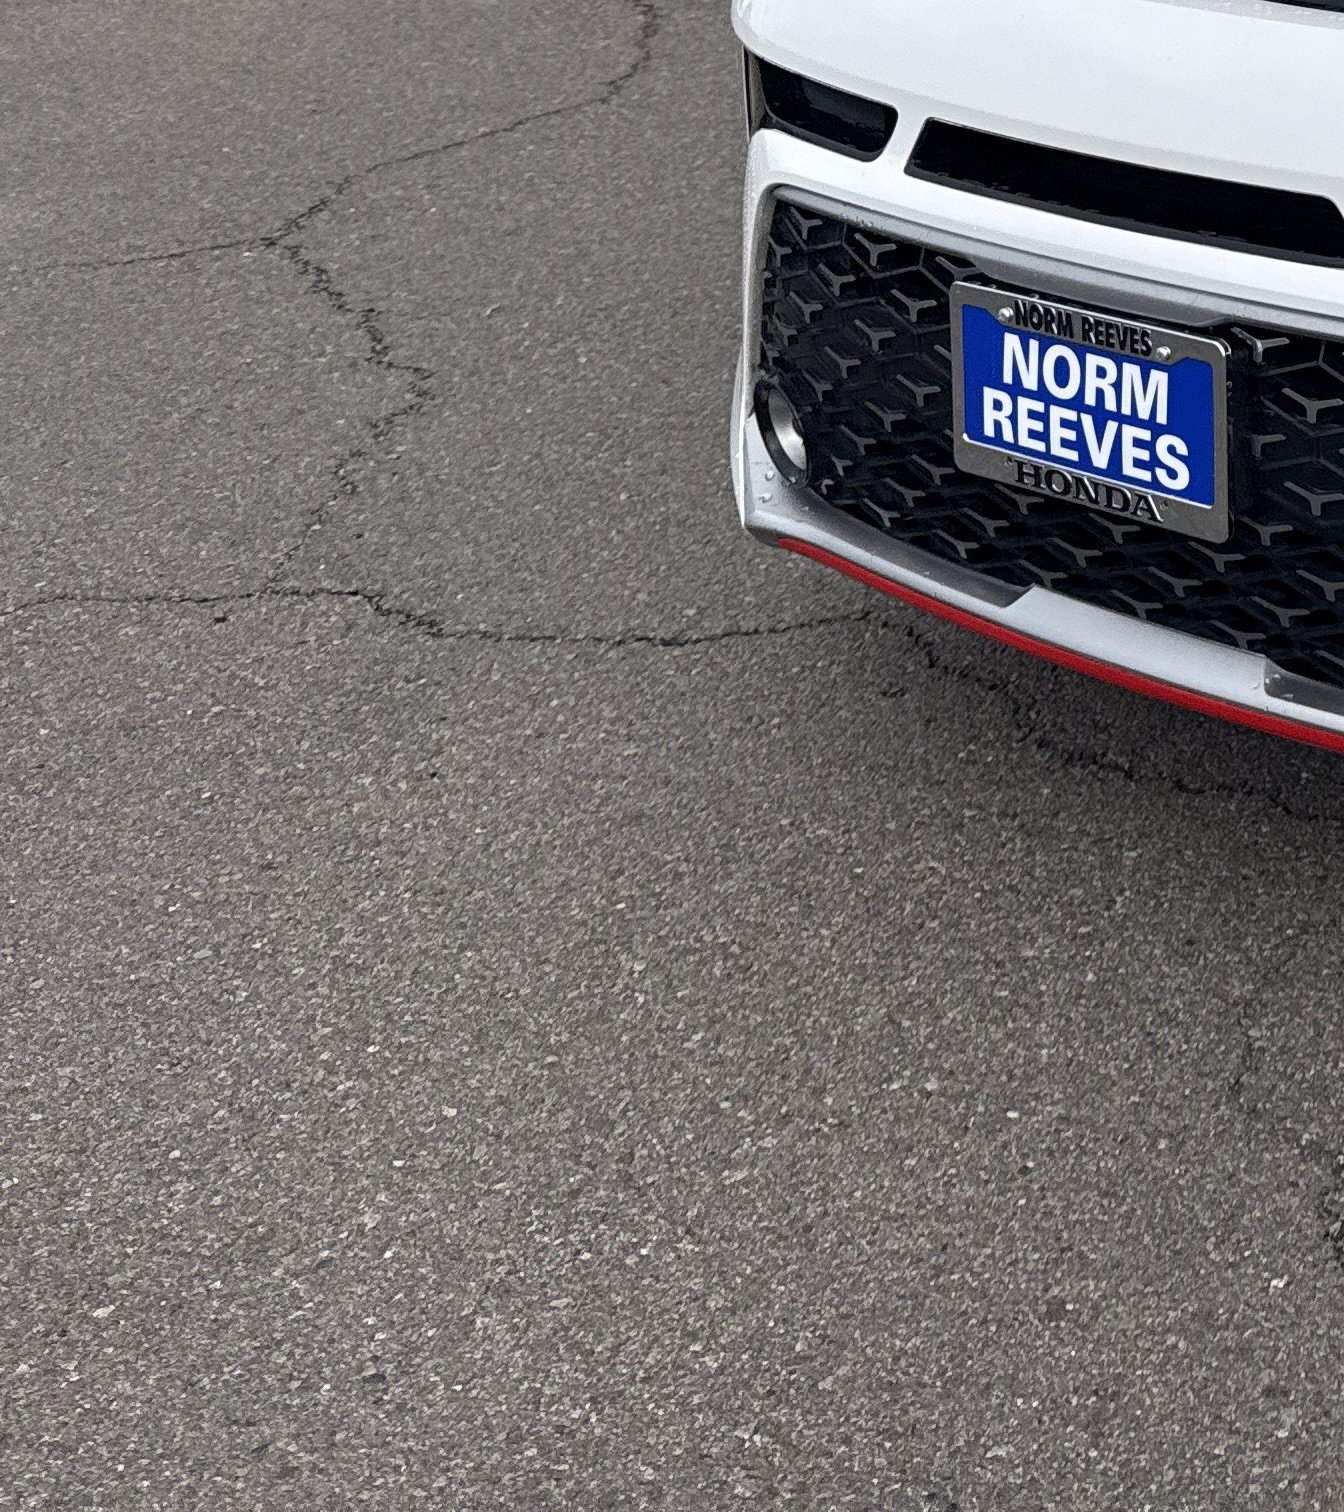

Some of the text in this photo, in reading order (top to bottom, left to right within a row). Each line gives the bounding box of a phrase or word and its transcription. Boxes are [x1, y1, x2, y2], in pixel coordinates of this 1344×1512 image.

[1014, 299, 1153, 357] NORM REEVES
[1002, 332, 1168, 425] NORM
[983, 386, 1190, 491] REEVES
[1014, 457, 1164, 522] HONDA
